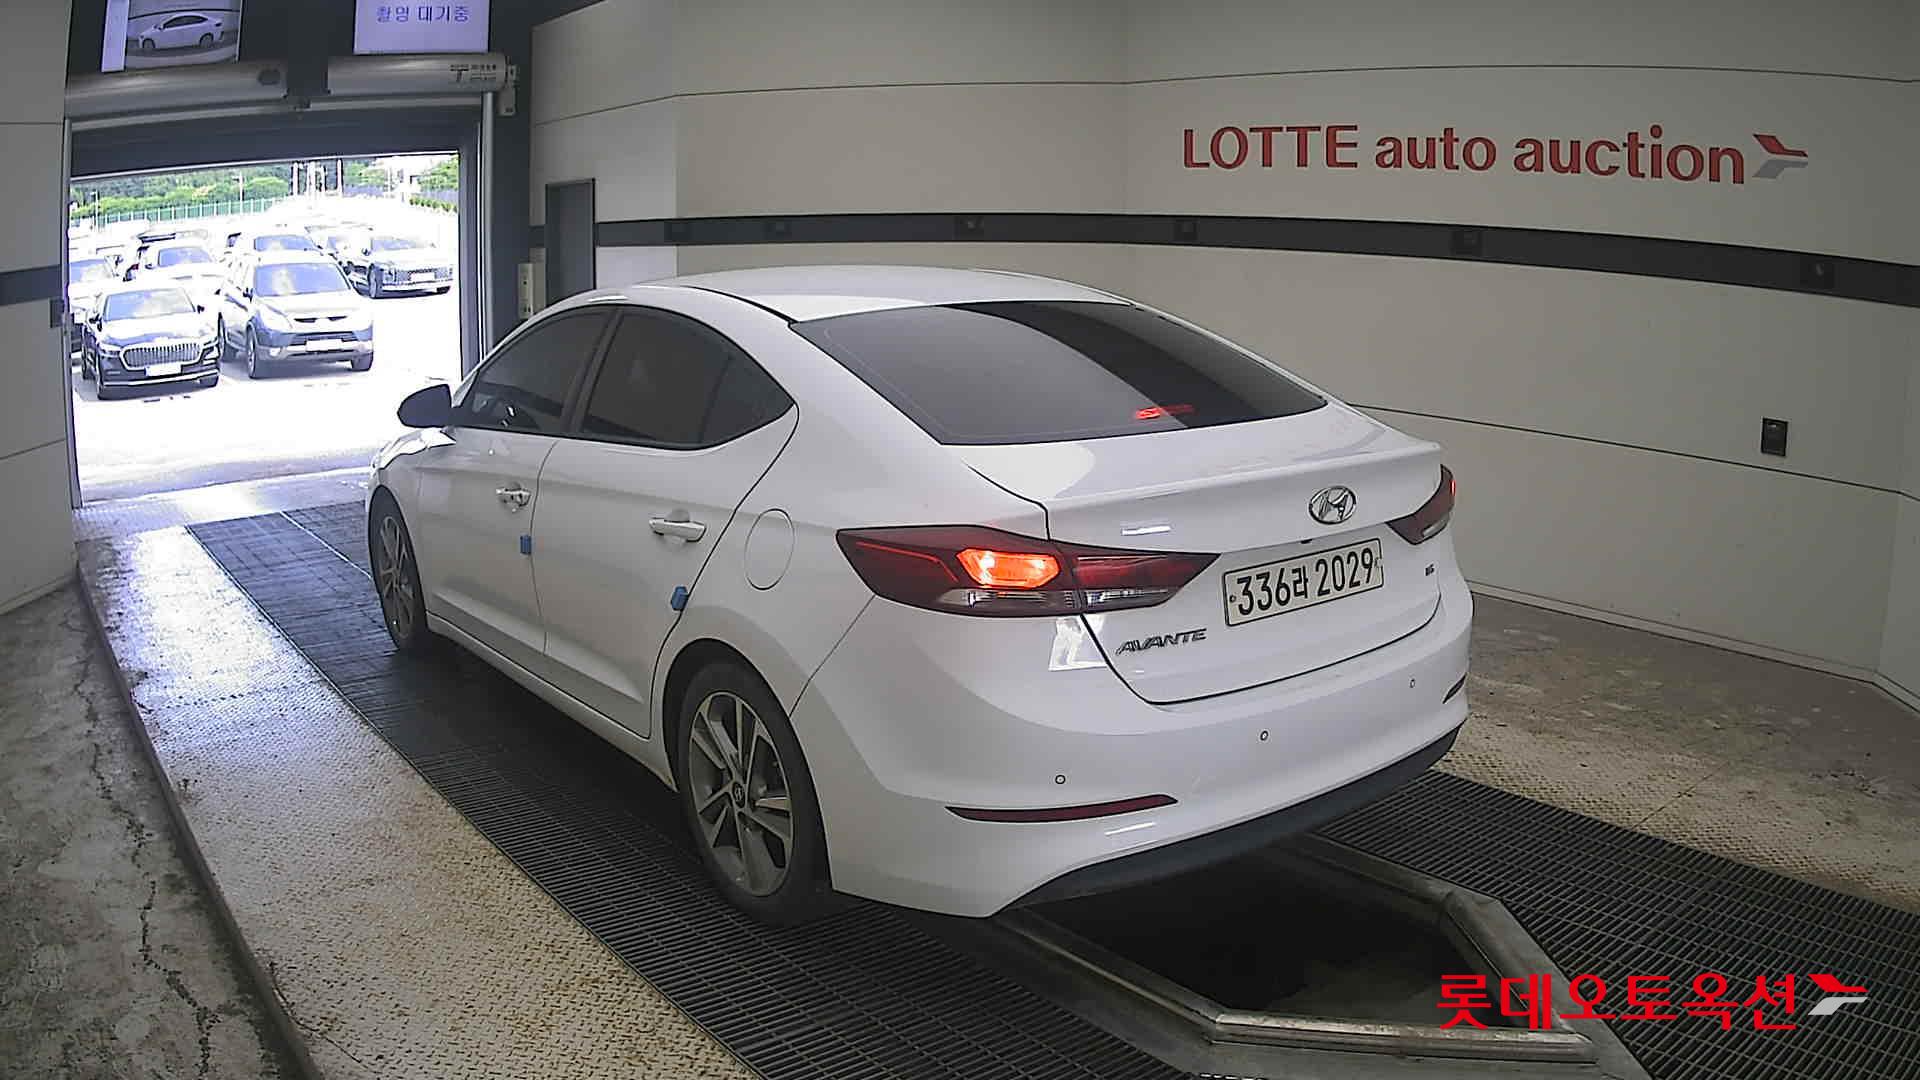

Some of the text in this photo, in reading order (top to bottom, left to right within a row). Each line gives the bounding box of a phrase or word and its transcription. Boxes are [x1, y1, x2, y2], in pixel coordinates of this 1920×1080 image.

[418, 6, 469, 23] 대기중
[1184, 124, 1745, 184] LOTTE auto auction
[1236, 548, 1375, 616] 336라 2029
[1116, 627, 1208, 655] AVANTE
